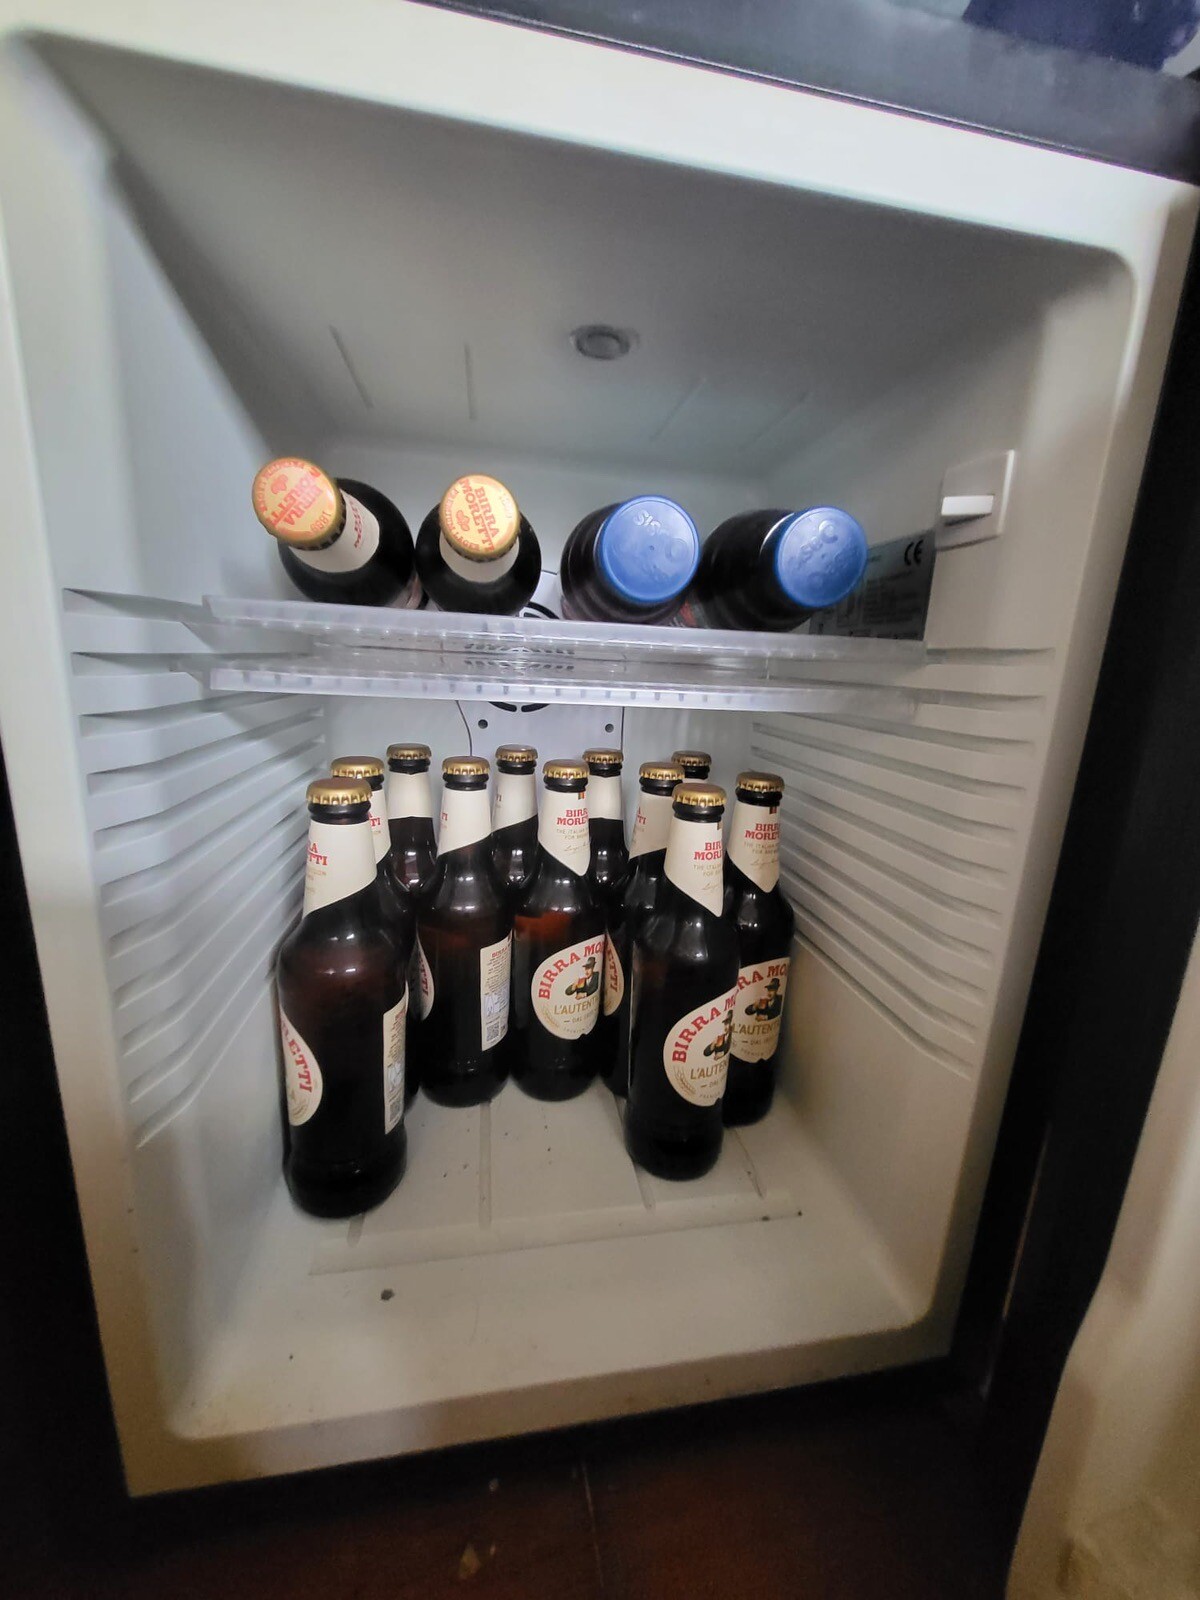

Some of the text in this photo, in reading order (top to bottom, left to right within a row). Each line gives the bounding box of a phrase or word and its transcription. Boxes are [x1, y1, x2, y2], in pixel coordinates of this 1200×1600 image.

[265, 466, 321, 527] MORETTI
[283, 485, 323, 526] BIRRA
[458, 478, 495, 552] MORETTI
[475, 486, 499, 537] BIRRA
[539, 952, 581, 999] BIRRA
[283, 1022, 313, 1093] ETTI
[672, 1007, 722, 1063] BIRRA
